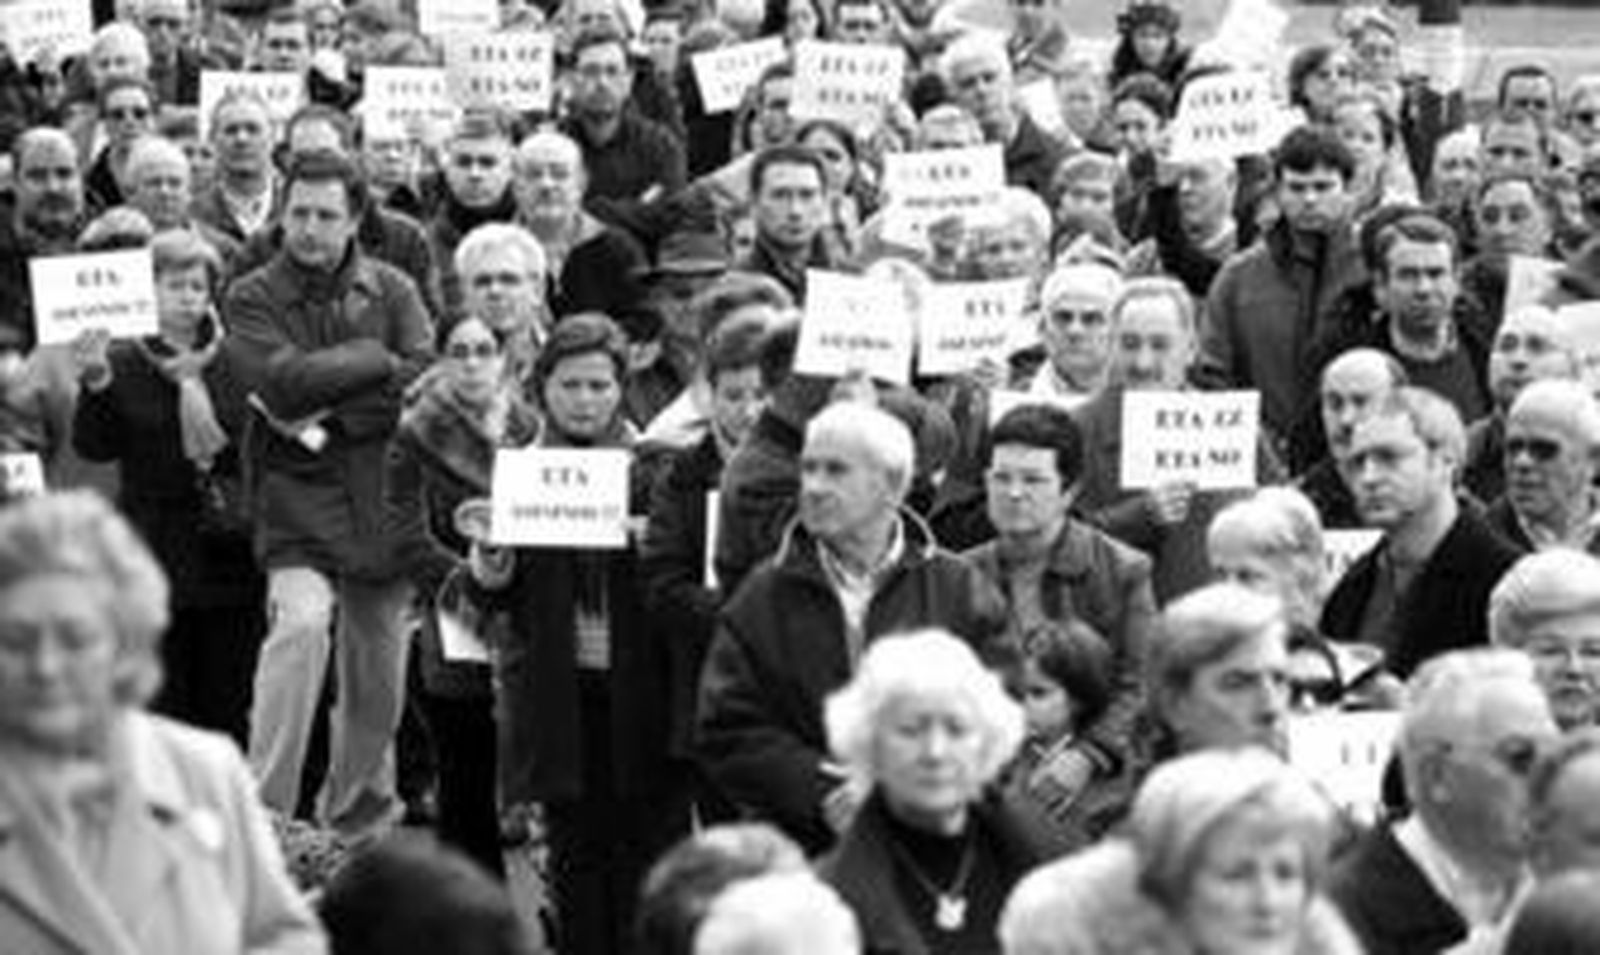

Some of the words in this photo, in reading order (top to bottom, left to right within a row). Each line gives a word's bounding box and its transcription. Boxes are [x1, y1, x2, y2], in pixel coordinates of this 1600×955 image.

[1155, 408, 1204, 430] ETA
[1155, 450, 1200, 470] ETA
[541, 466, 589, 488] ETA
